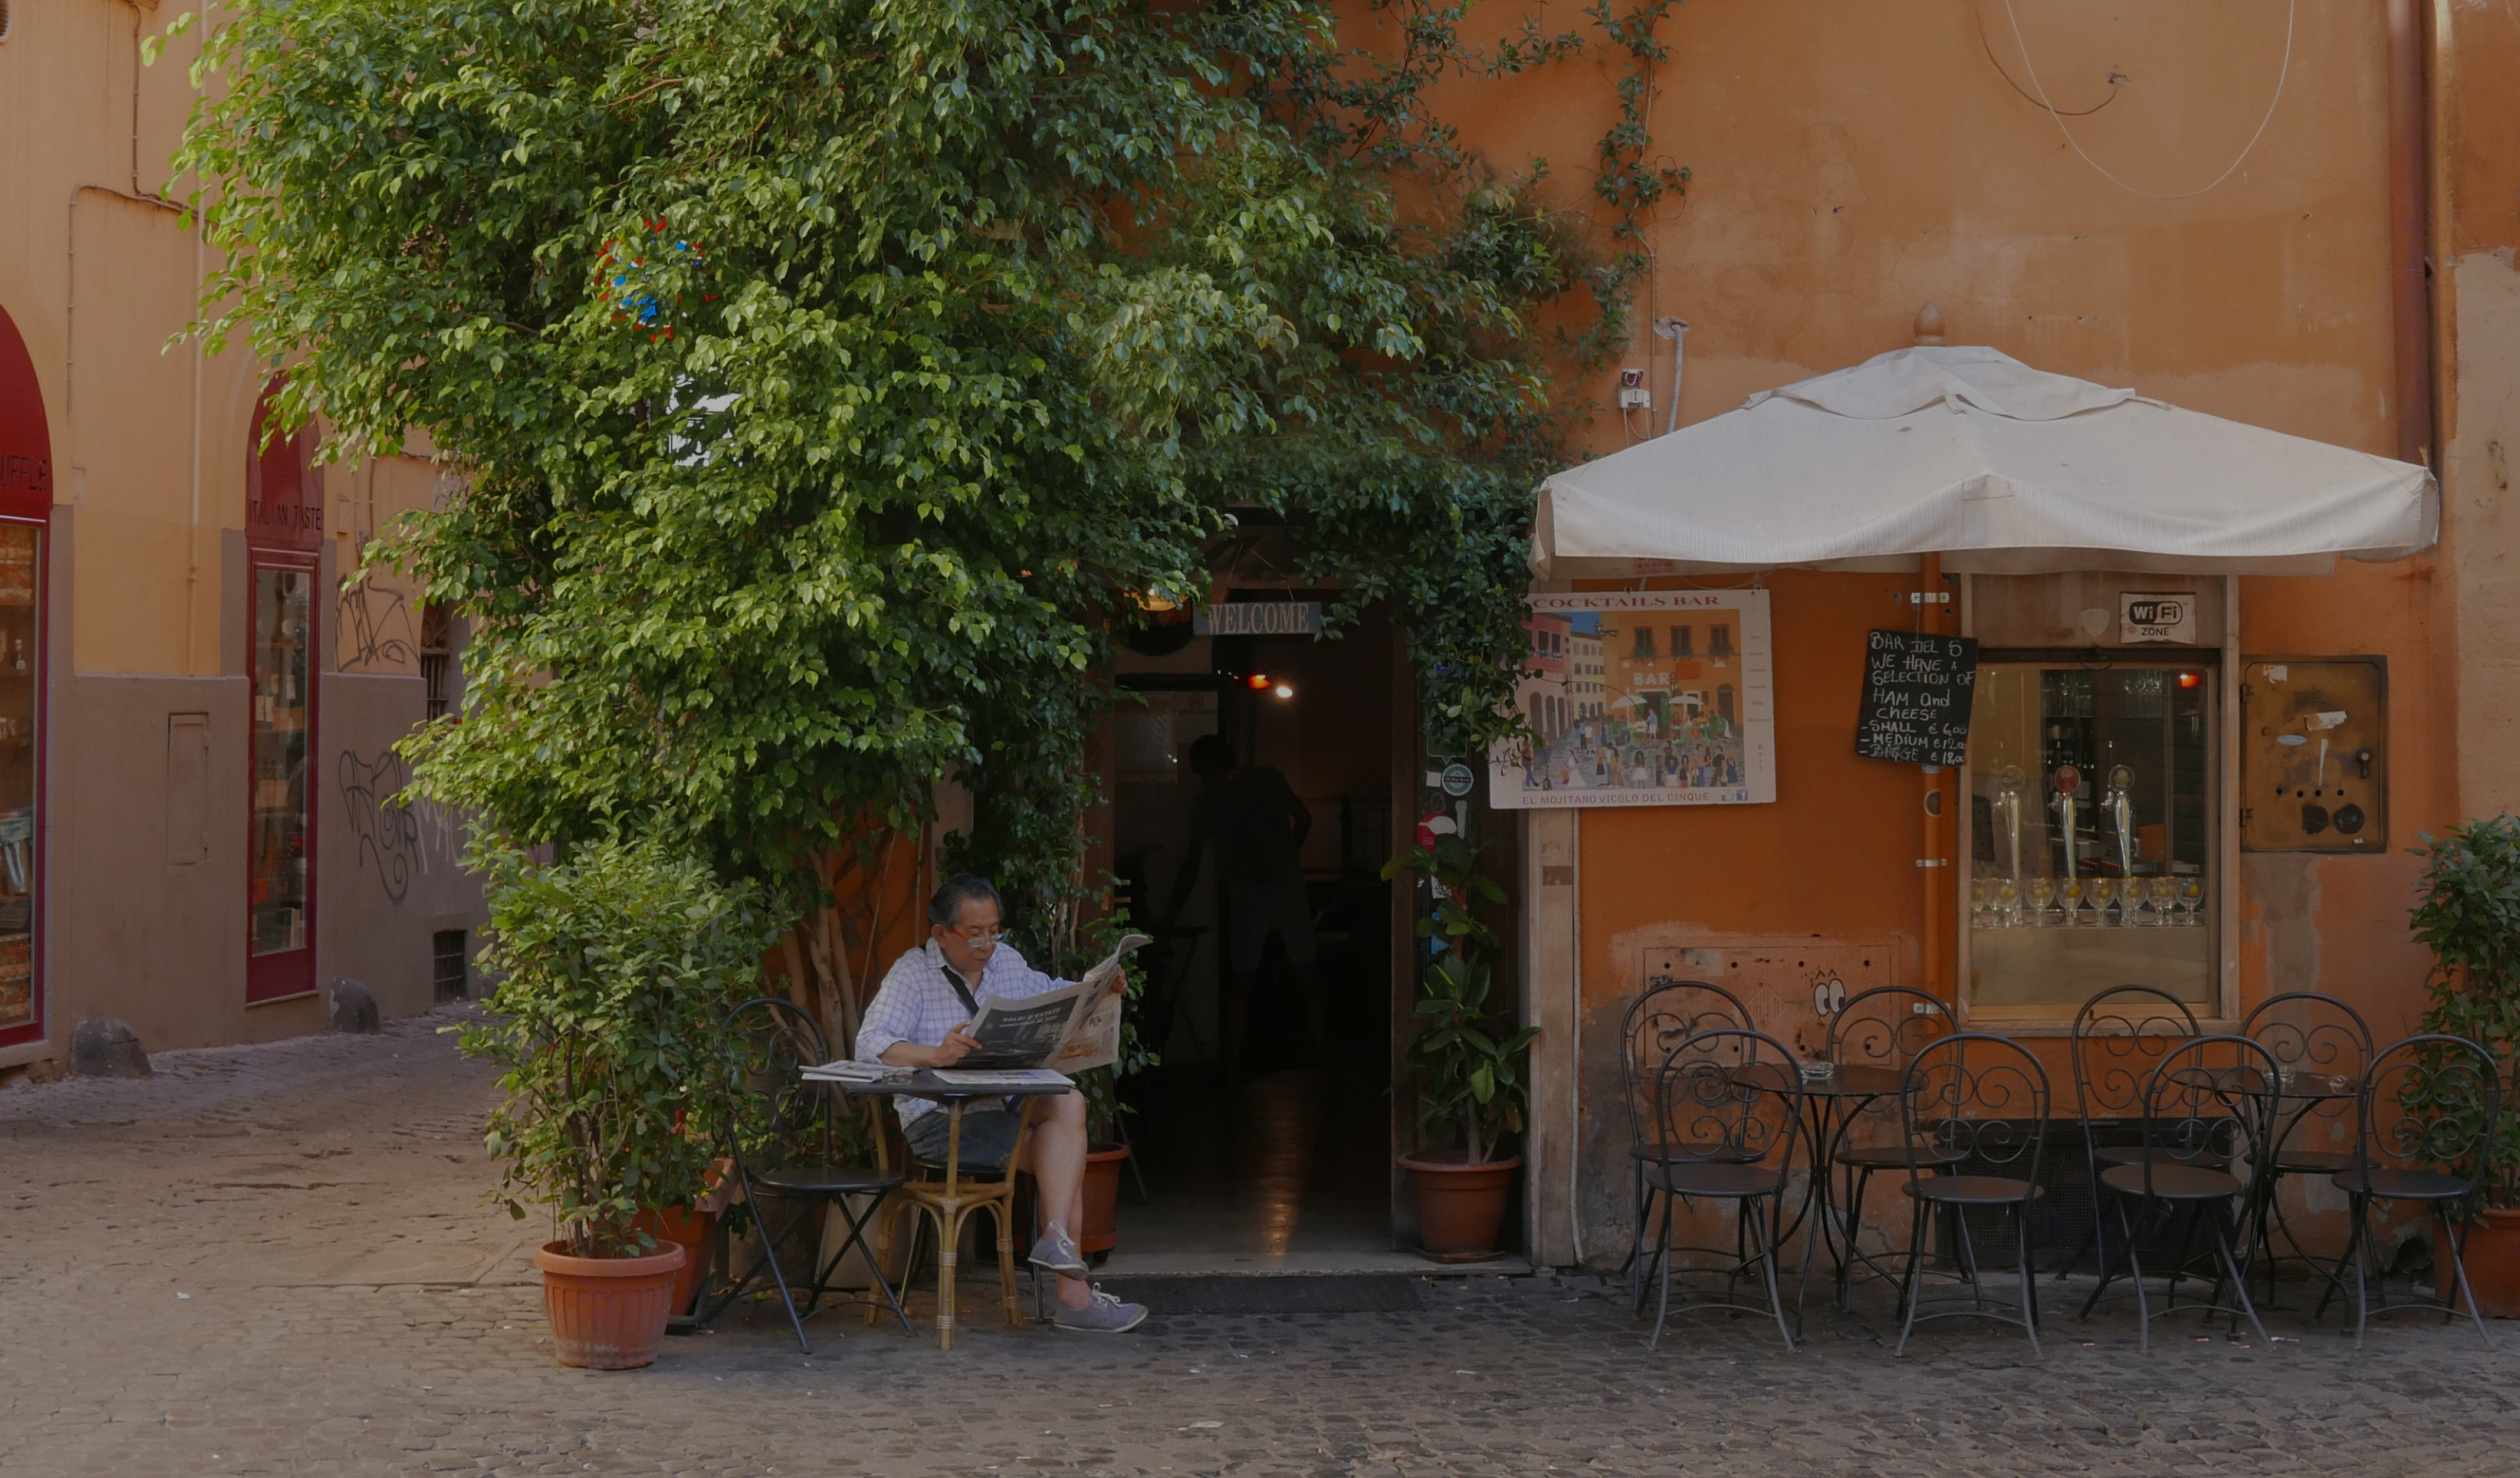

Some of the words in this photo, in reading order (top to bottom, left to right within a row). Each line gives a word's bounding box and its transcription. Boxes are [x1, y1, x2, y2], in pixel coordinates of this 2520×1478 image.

[248, 499, 288, 527] ITALIAN
[294, 506, 321, 531] TASTE
[1532, 596, 1666, 609] COCKTAILS
[1674, 596, 1719, 606] BAR
[1208, 603, 1309, 635] WELCOME
[2141, 628, 2170, 636] ZONE
[1870, 631, 1904, 651] BAR
[1910, 639, 1939, 653] DEL
[1948, 640, 1963, 657] 5
[1872, 653, 1895, 669] WE
[1902, 654, 1943, 672] HAVE
[1951, 661, 1957, 670] A
[1634, 672, 1670, 685] BAR
[1872, 670, 1950, 686] SELECTION
[1957, 670, 1976, 685] OF
[1872, 688, 1909, 706] HAM
[1869, 720, 1917, 733] SMALL
[1873, 733, 1928, 749] MEDIUM
[1522, 796, 1535, 805] EL
[1541, 795, 1596, 804] MOJITARO
[1599, 793, 1639, 803] VICOLO
[1642, 793, 1663, 802] DEL
[1668, 792, 1709, 801] CINQUE
